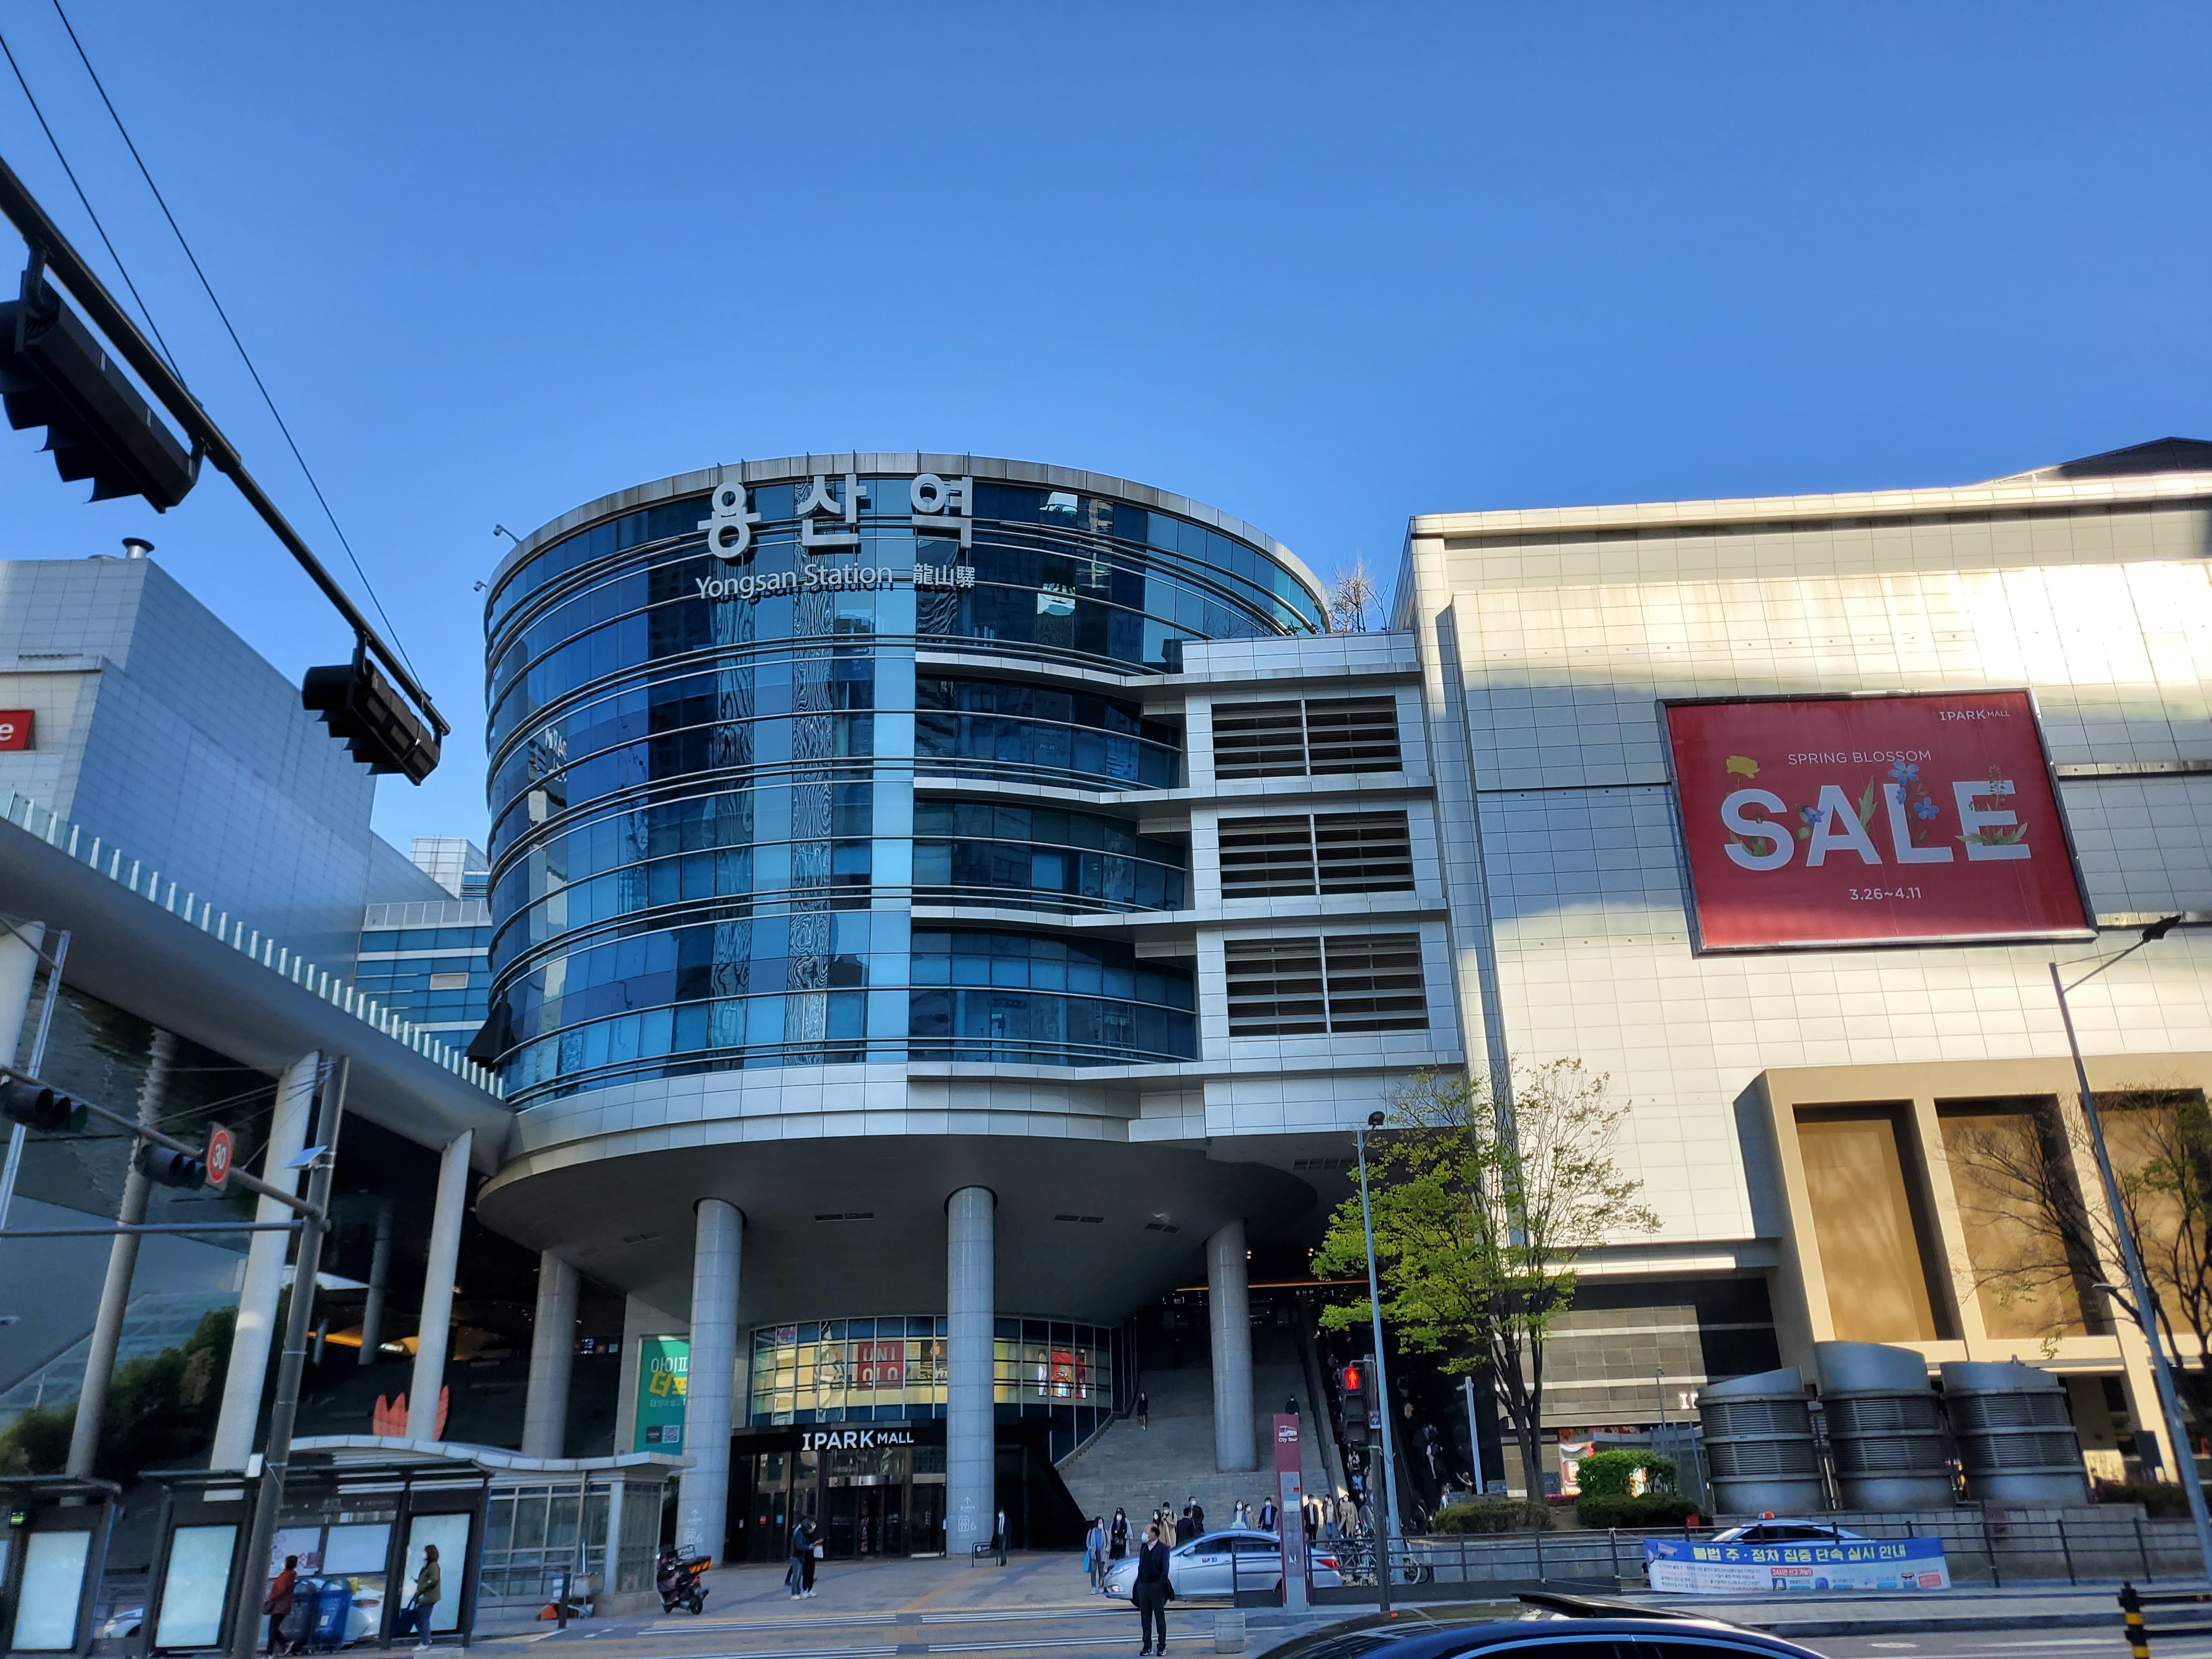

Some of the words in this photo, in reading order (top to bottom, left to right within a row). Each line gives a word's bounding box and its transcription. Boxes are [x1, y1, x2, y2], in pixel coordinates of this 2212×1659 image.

[697, 473, 973, 558] 용산역
[696, 571, 797, 599] Yongsan
[804, 562, 893, 586] Station
[912, 563, 975, 589] 龍山驛
[1987, 709, 2011, 718] MALL
[1788, 752, 1847, 765] SPRING
[1853, 750, 1932, 763] BLOSSOM
[1721, 780, 2032, 871] SALE
[1849, 887, 1922, 901] 3.26~4.11
[213, 1143, 227, 1170] 30
[863, 1347, 895, 1362] UNI
[877, 1430, 915, 1444] MALL
[1693, 1547, 1722, 1561] 불법
[1784, 1548, 1812, 1562] 집중
[1815, 1548, 1844, 1562] 단속
[1848, 1546, 1875, 1561] 실시
[1879, 1544, 1906, 1559] 안내
